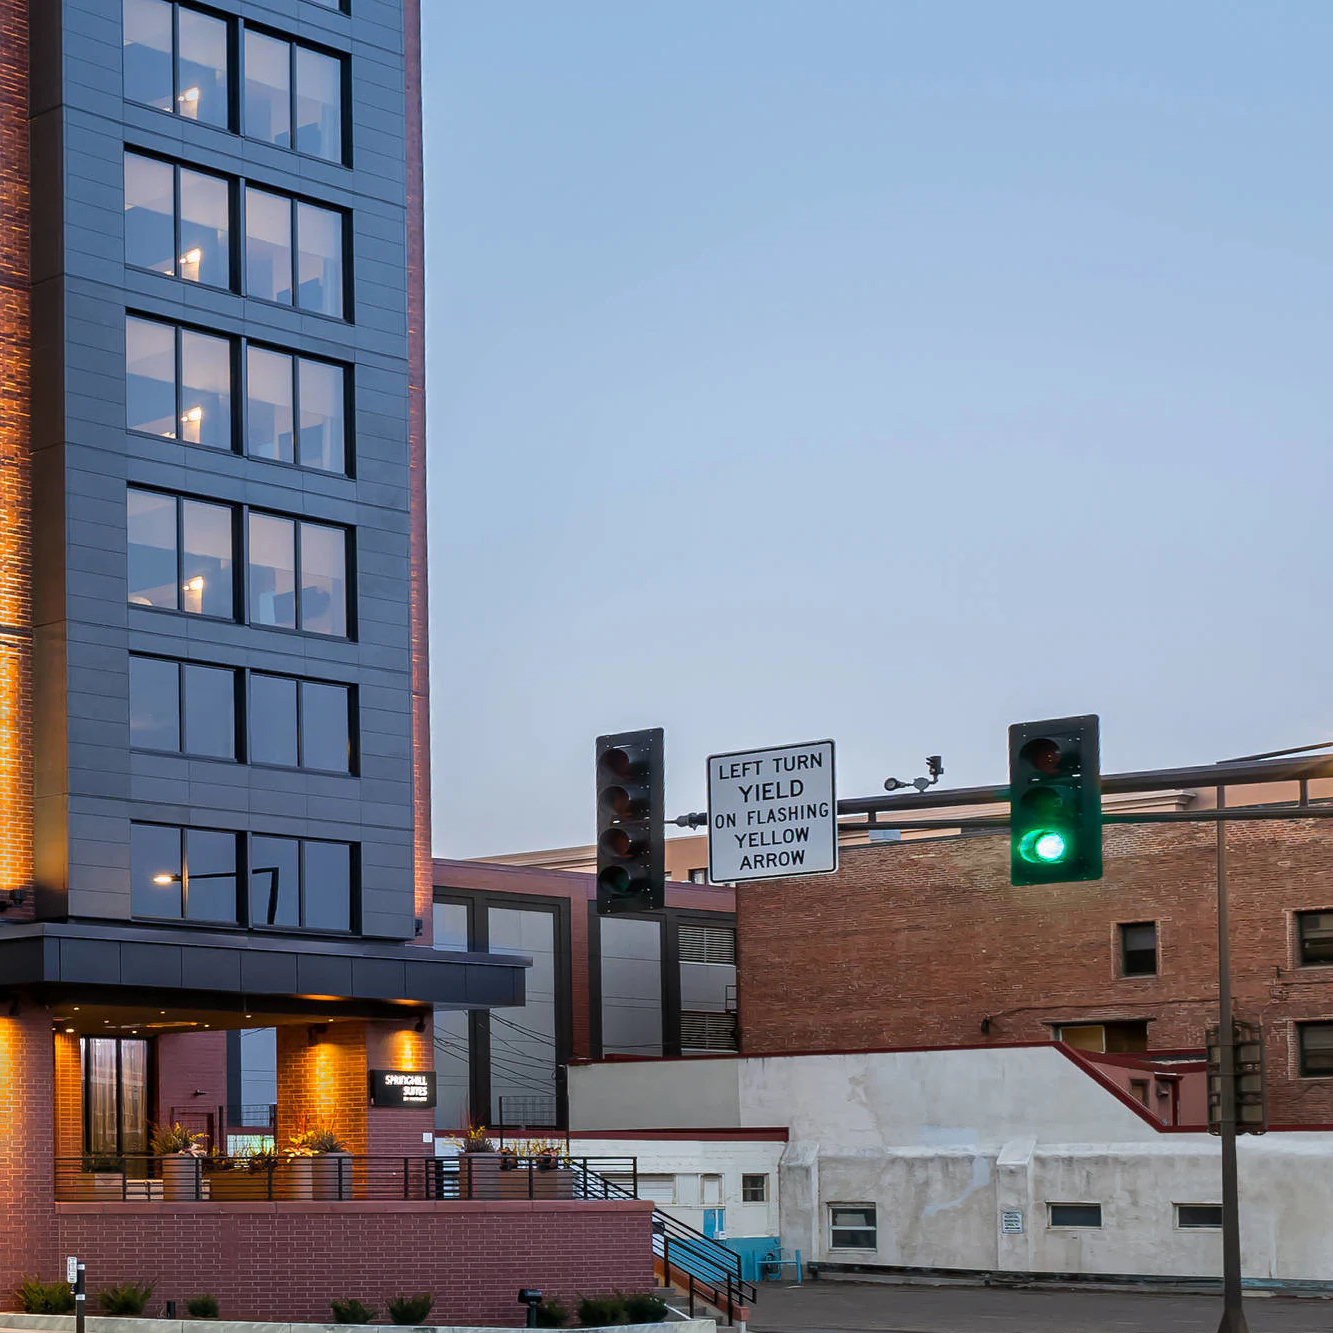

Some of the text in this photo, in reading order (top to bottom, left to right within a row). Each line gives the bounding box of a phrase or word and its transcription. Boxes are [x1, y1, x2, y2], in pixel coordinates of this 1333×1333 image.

[718, 752, 822, 780] LEFT TURN
[738, 779, 804, 803] YIELD
[715, 802, 829, 829] ON FLASHING
[734, 826, 810, 849] YELLOW
[739, 849, 805, 871] ARROW
